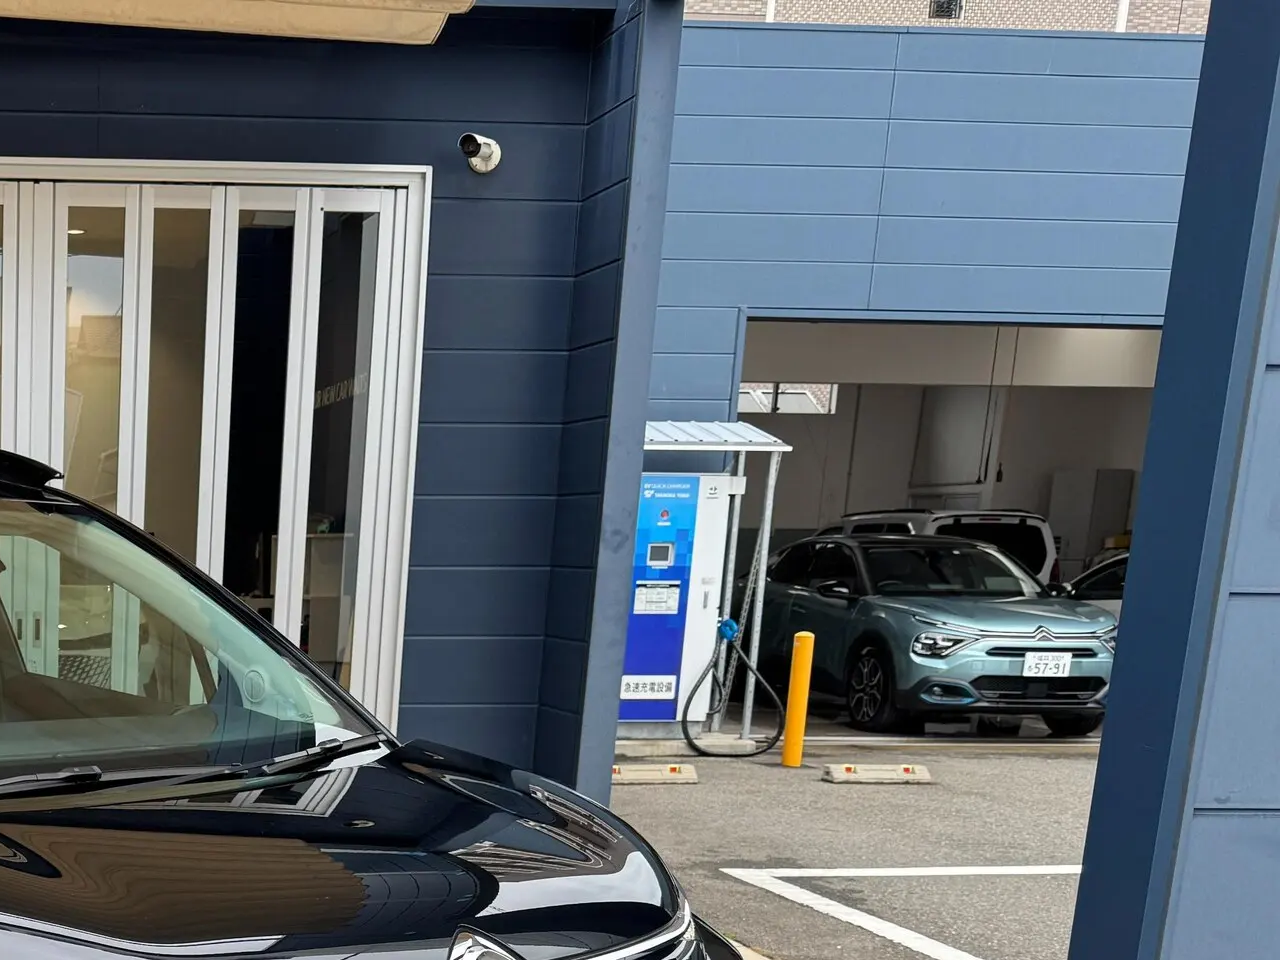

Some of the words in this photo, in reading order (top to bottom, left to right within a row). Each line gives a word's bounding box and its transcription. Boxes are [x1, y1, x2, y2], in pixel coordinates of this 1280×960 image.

[624, 682, 672, 693] 急速充電設備
